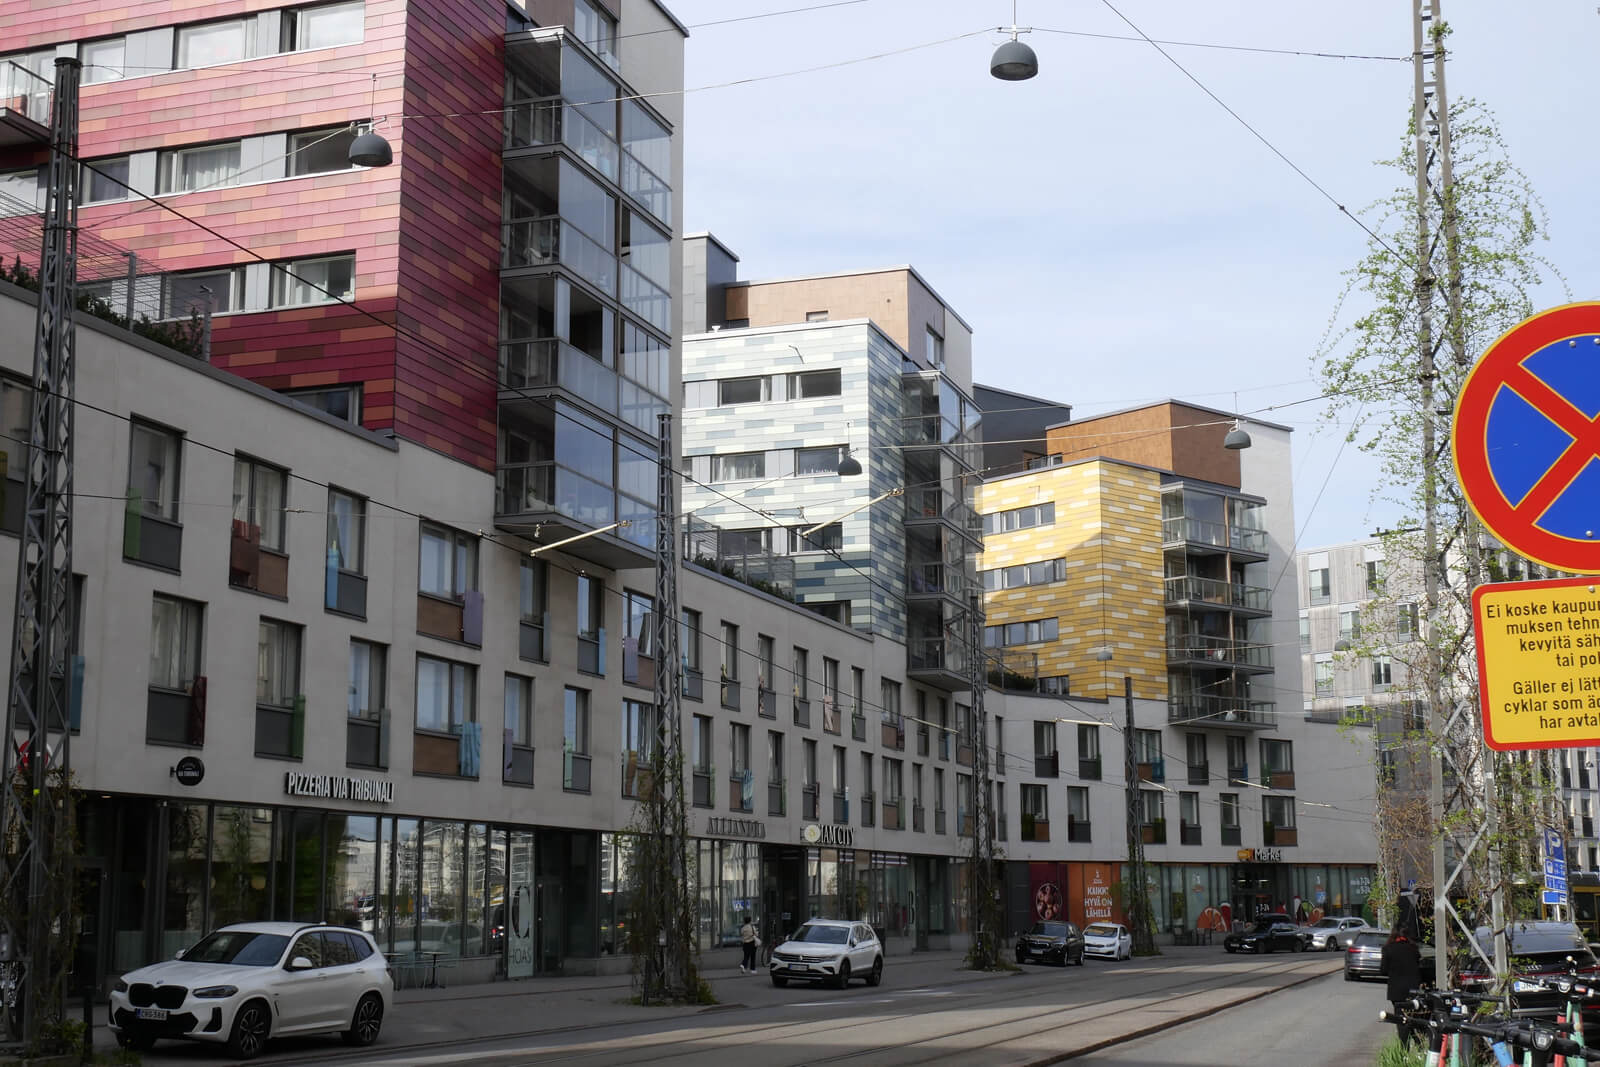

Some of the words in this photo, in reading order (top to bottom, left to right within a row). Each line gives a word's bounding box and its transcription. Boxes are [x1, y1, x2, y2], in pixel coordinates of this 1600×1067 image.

[1487, 604, 1501, 618] Ei
[1505, 602, 1547, 617] koske
[1506, 620, 1563, 635] muksen
[1568, 616, 1600, 630] tehn
[1519, 635, 1571, 652] kevyitä
[1556, 653, 1574, 667] tai
[1513, 679, 1556, 695] Gäller
[1561, 678, 1574, 694] ej
[1504, 698, 1547, 715] cyklar
[1552, 699, 1583, 711] som
[1539, 715, 1563, 729] har
[287, 772, 331, 797] PIZZERIA
[332, 776, 348, 799] VIA
[350, 778, 395, 803] TRIBUNALI
[1547, 830, 1561, 857] P
[1254, 847, 1282, 862] Marke
